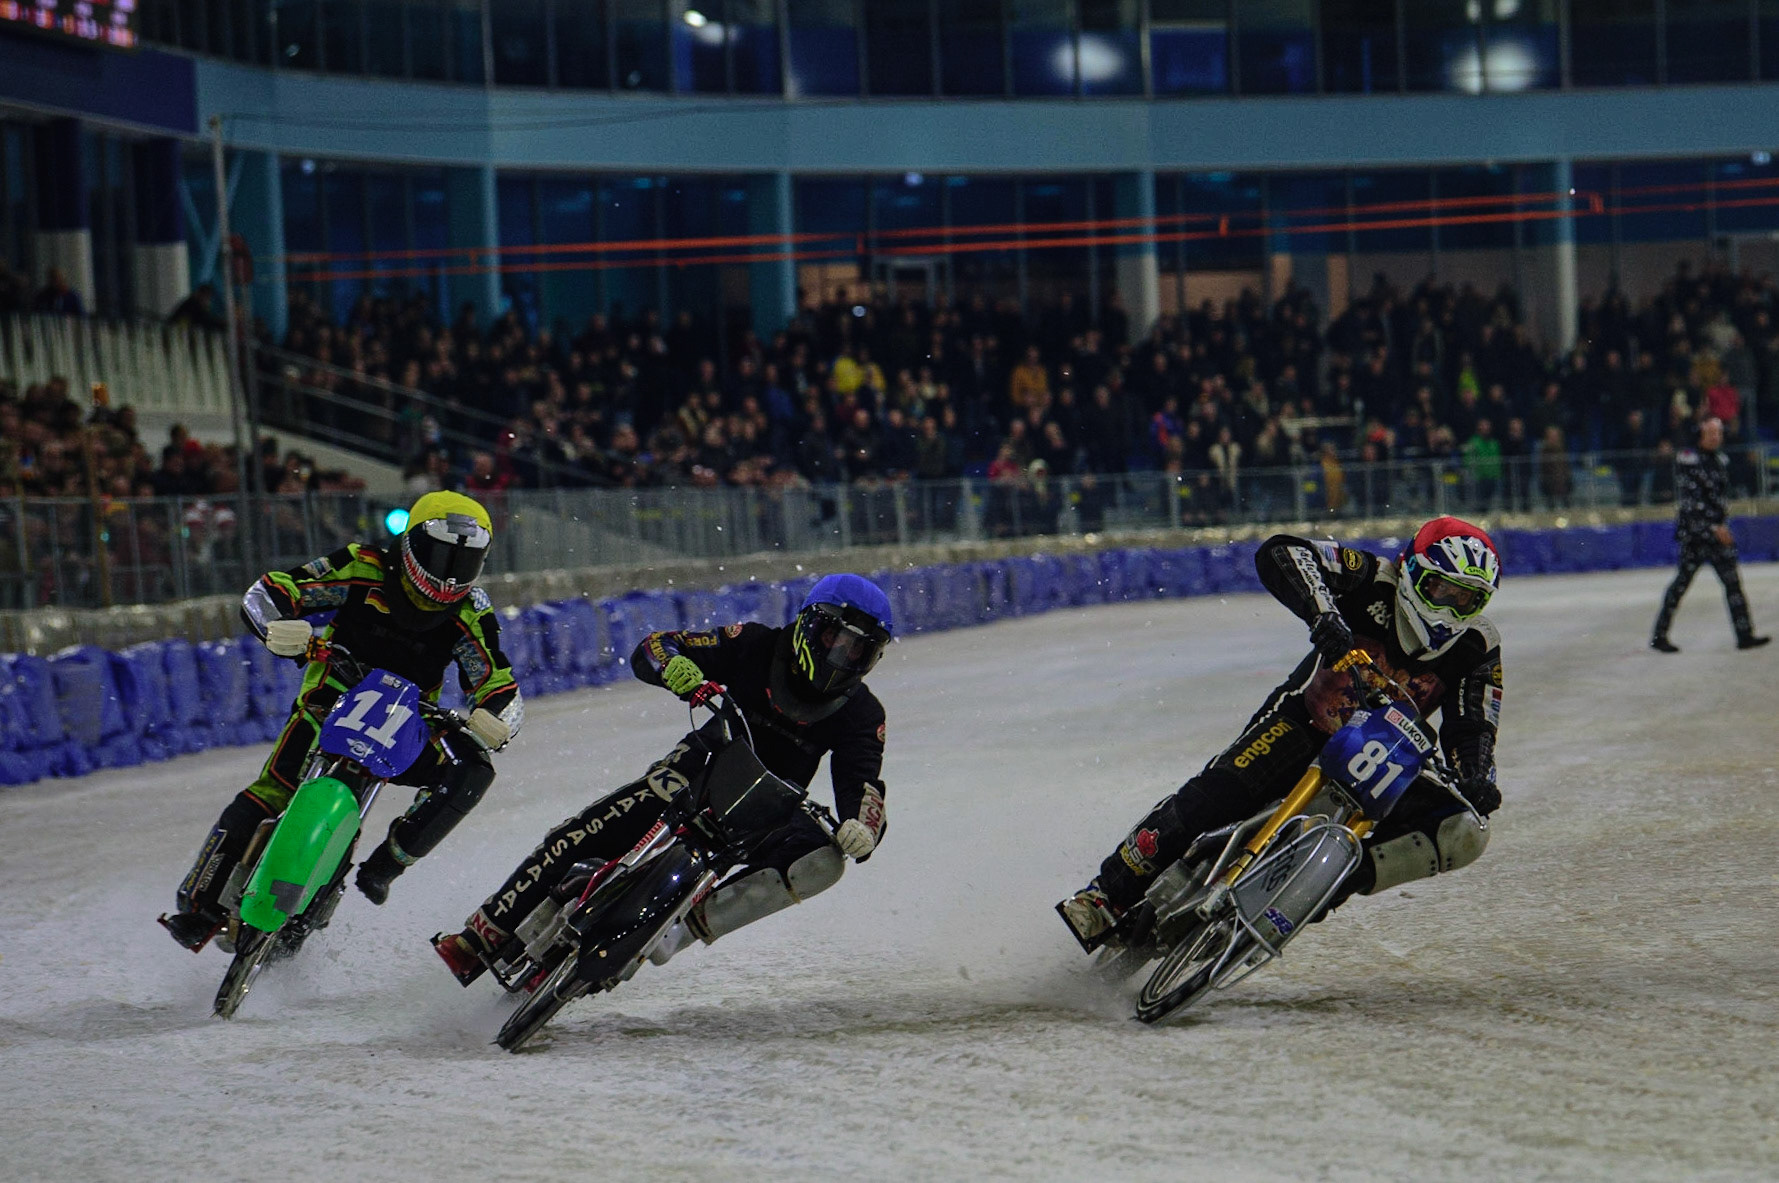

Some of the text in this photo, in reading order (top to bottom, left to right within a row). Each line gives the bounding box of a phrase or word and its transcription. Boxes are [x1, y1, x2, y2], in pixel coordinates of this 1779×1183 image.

[333, 689, 414, 750] 11
[1233, 720, 1293, 768] engcon
[1398, 718, 1429, 751] LUKOIL
[1347, 740, 1404, 800] 81
[493, 787, 655, 918] KATSASTAJAT
